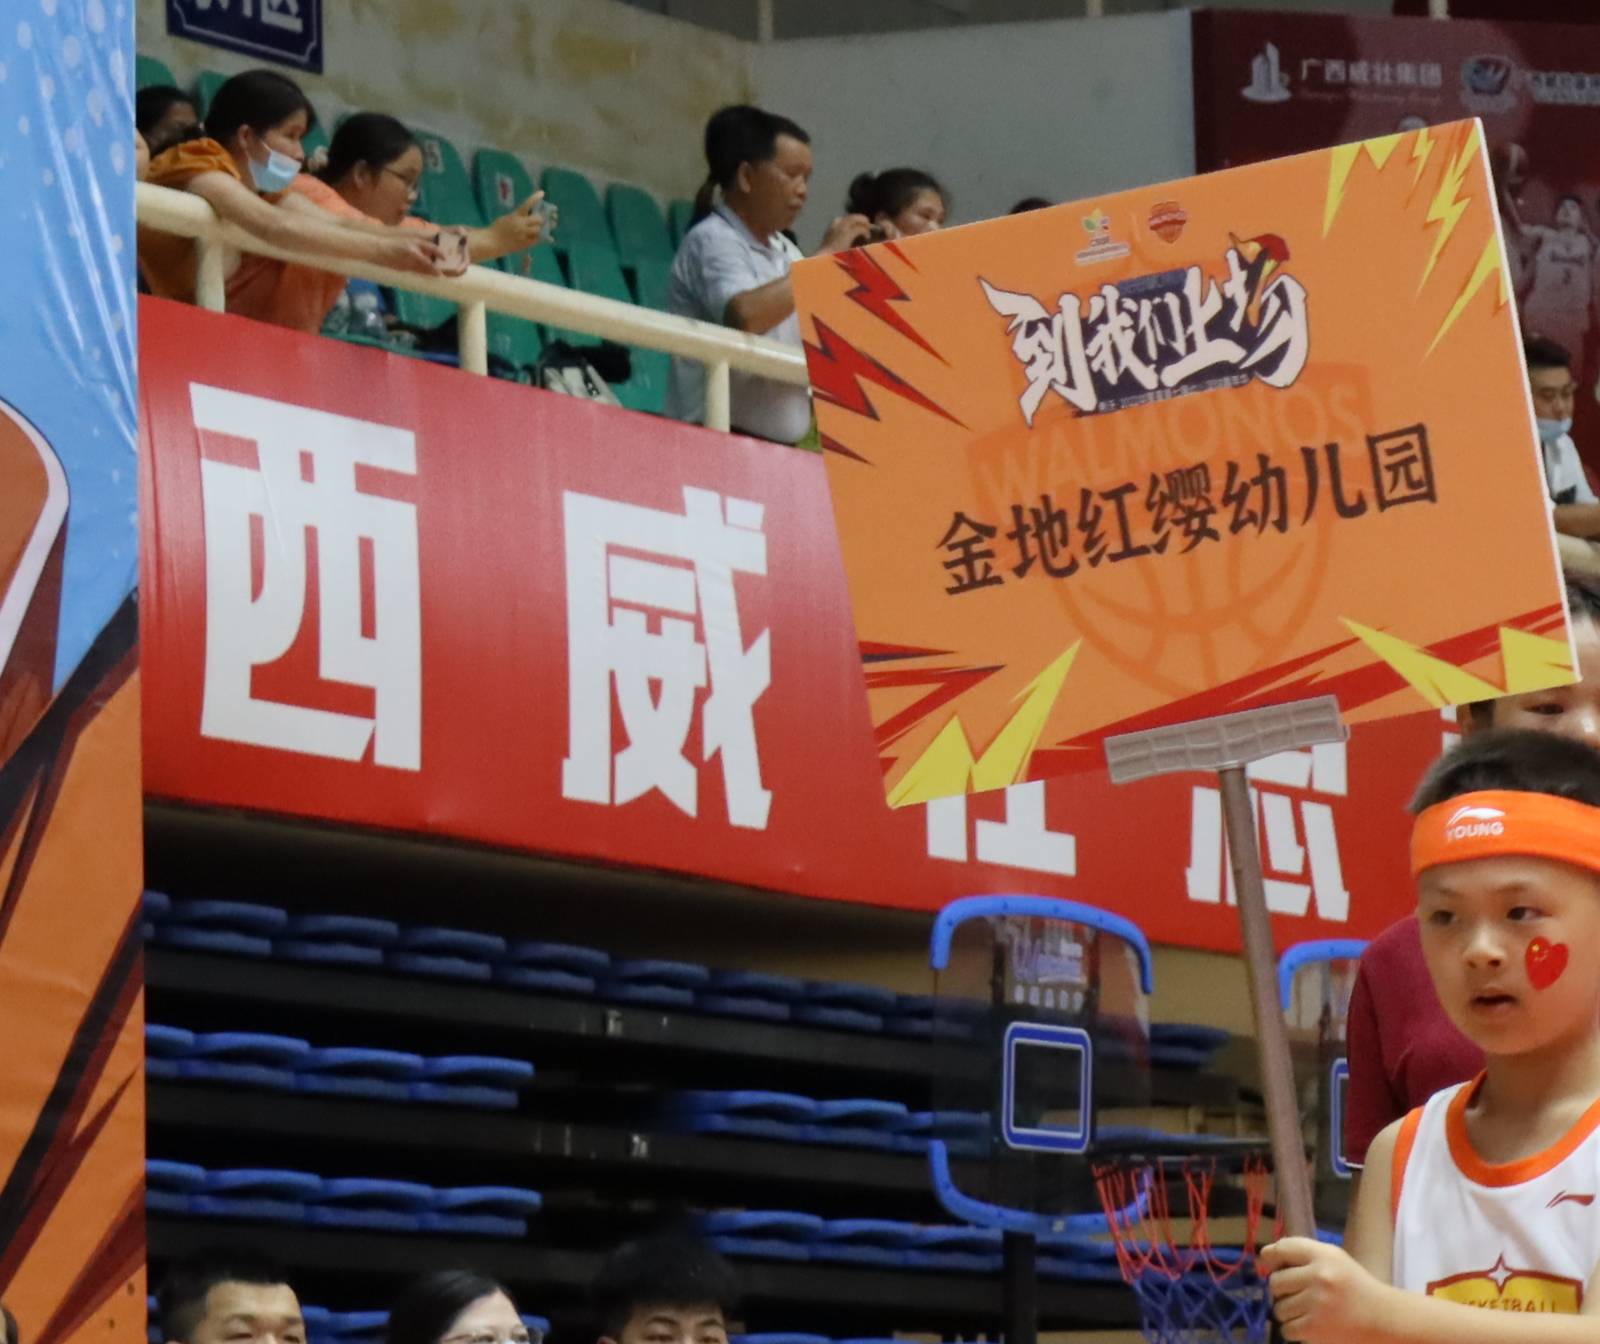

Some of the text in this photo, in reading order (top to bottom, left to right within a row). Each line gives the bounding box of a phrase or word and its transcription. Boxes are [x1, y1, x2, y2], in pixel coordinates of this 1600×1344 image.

[938, 421, 1438, 598] 金地红缨幼儿园
[1447, 822, 1505, 842] YOUNG
